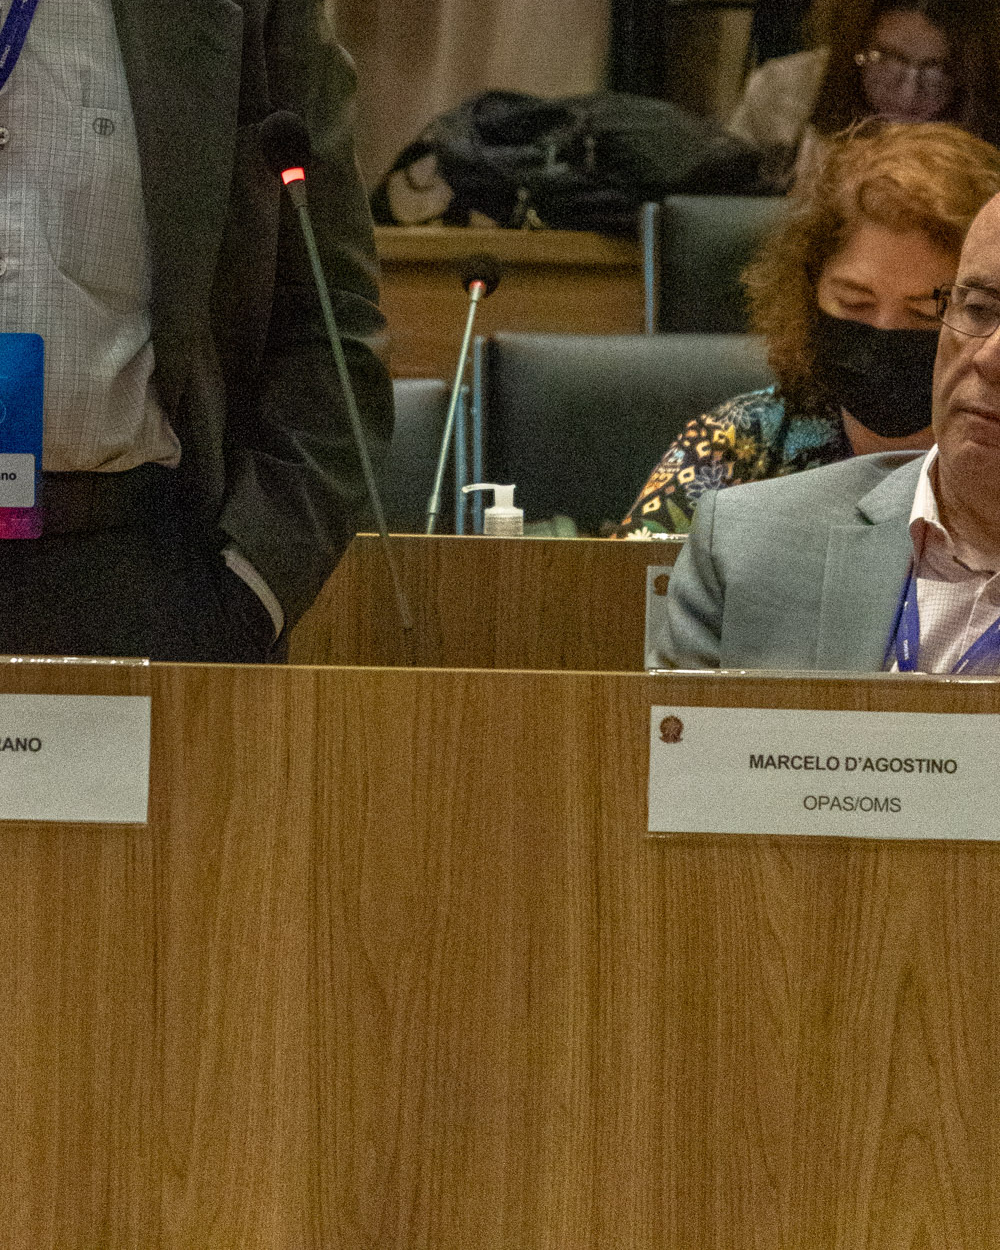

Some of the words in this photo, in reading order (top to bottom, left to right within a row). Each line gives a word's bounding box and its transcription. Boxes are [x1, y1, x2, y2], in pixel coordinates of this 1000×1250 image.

[749, 754, 840, 771] MARCELO
[845, 757, 958, 774] D’AGOSTINO
[803, 794, 901, 813] OPAS/OMS
